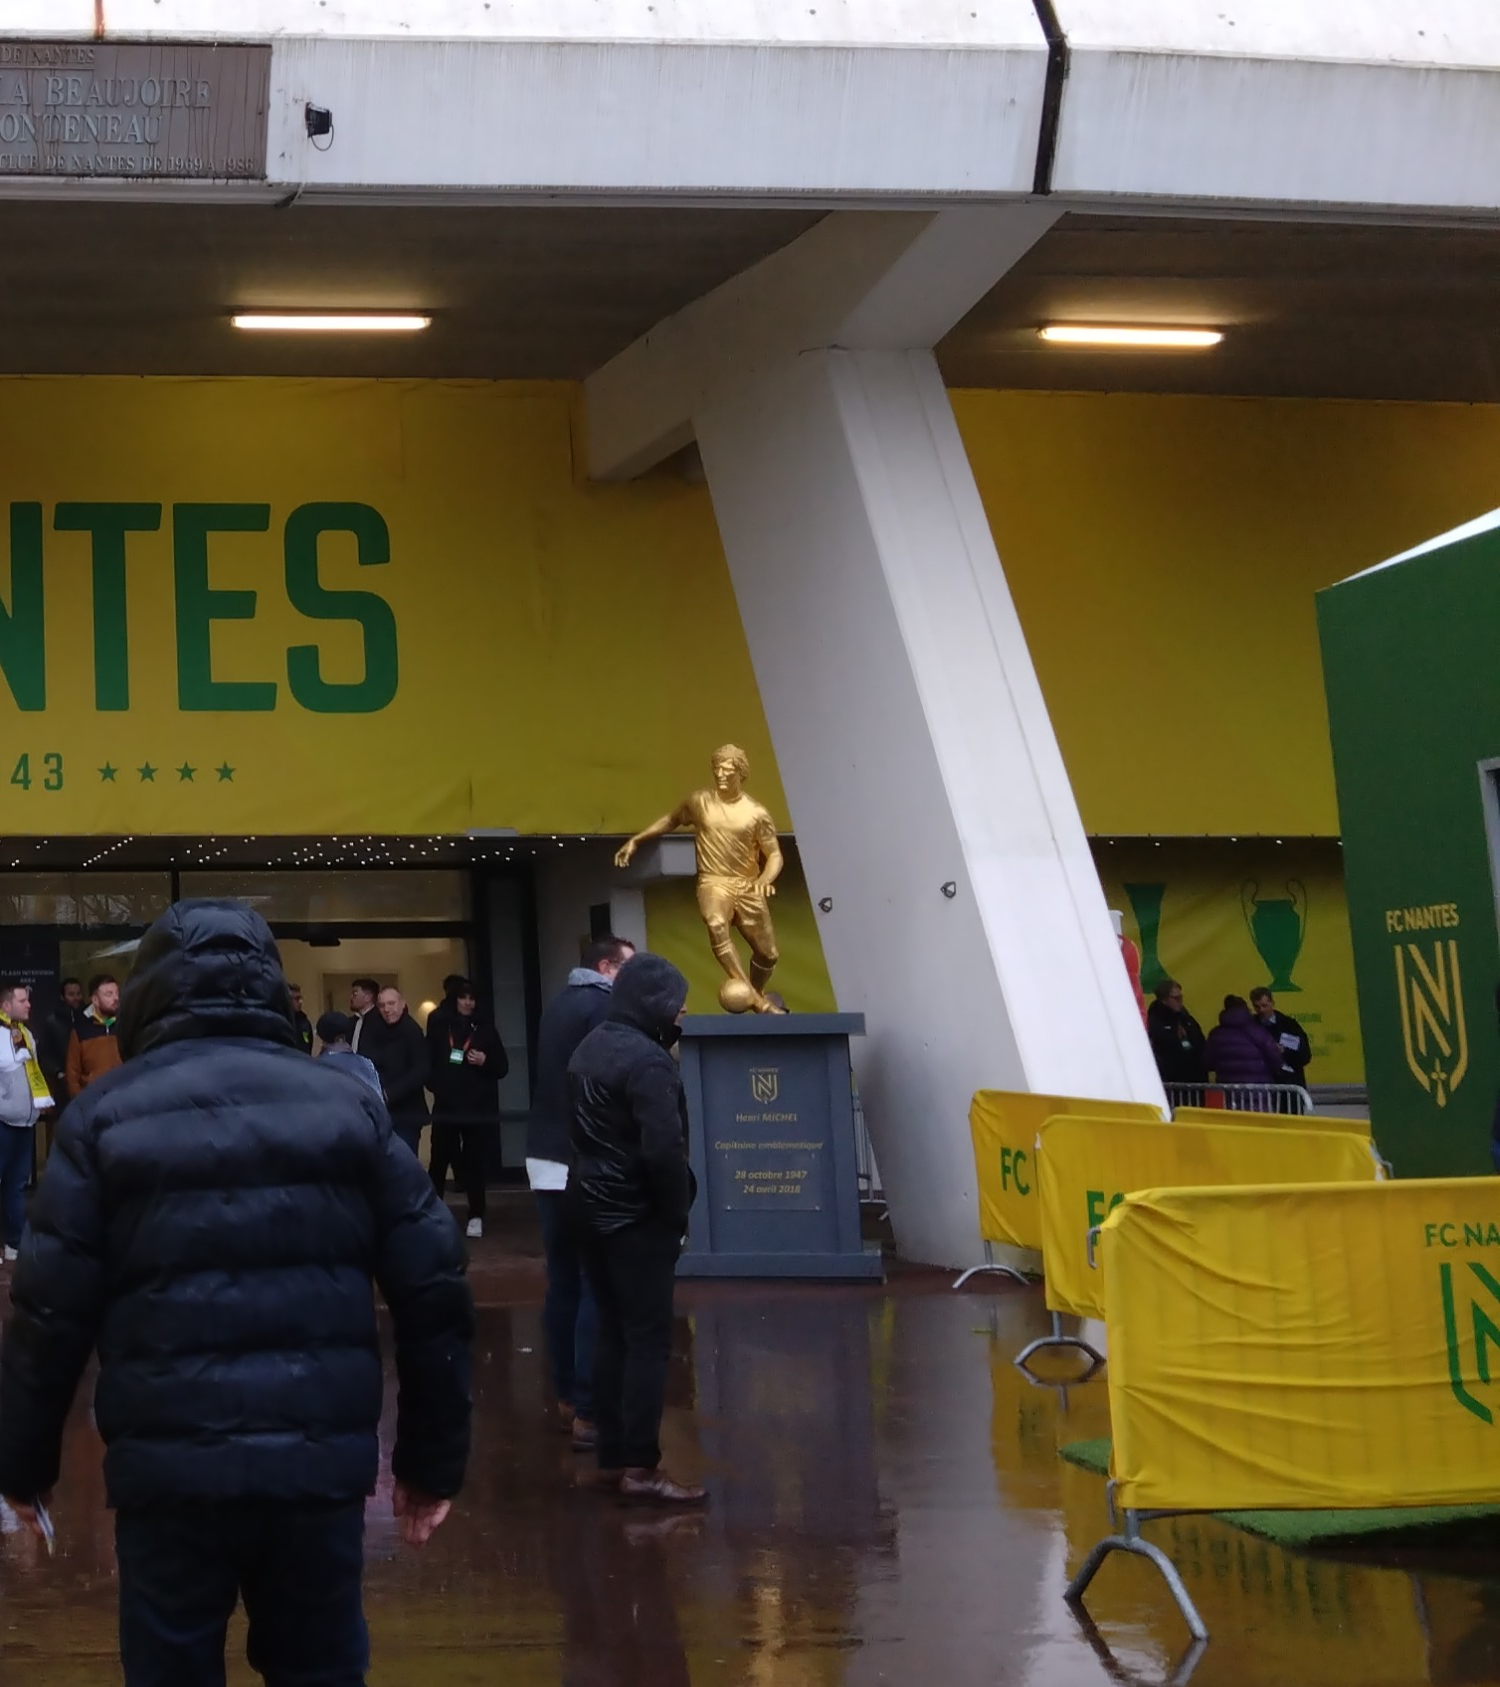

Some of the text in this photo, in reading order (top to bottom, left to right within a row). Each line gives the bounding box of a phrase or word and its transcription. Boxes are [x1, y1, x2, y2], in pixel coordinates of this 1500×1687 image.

[0, 46, 22, 63] DE
[30, 47, 95, 64] NANTES
[45, 75, 212, 109] BEAUJOIRE
[45, 154, 65, 170] DE
[71, 155, 135, 171] NANTES
[142, 156, 162, 172] DE
[168, 156, 203, 172] 1969
[1385, 902, 1460, 933] FC NANTES
[735, 1112, 798, 1123] Henri MICHEL
[748, 1169, 783, 1180] octobre
[1001, 1147, 1030, 1196] FC
[743, 1184, 801, 1194] 24 avril 2018
[1425, 1223, 1457, 1248] FC
